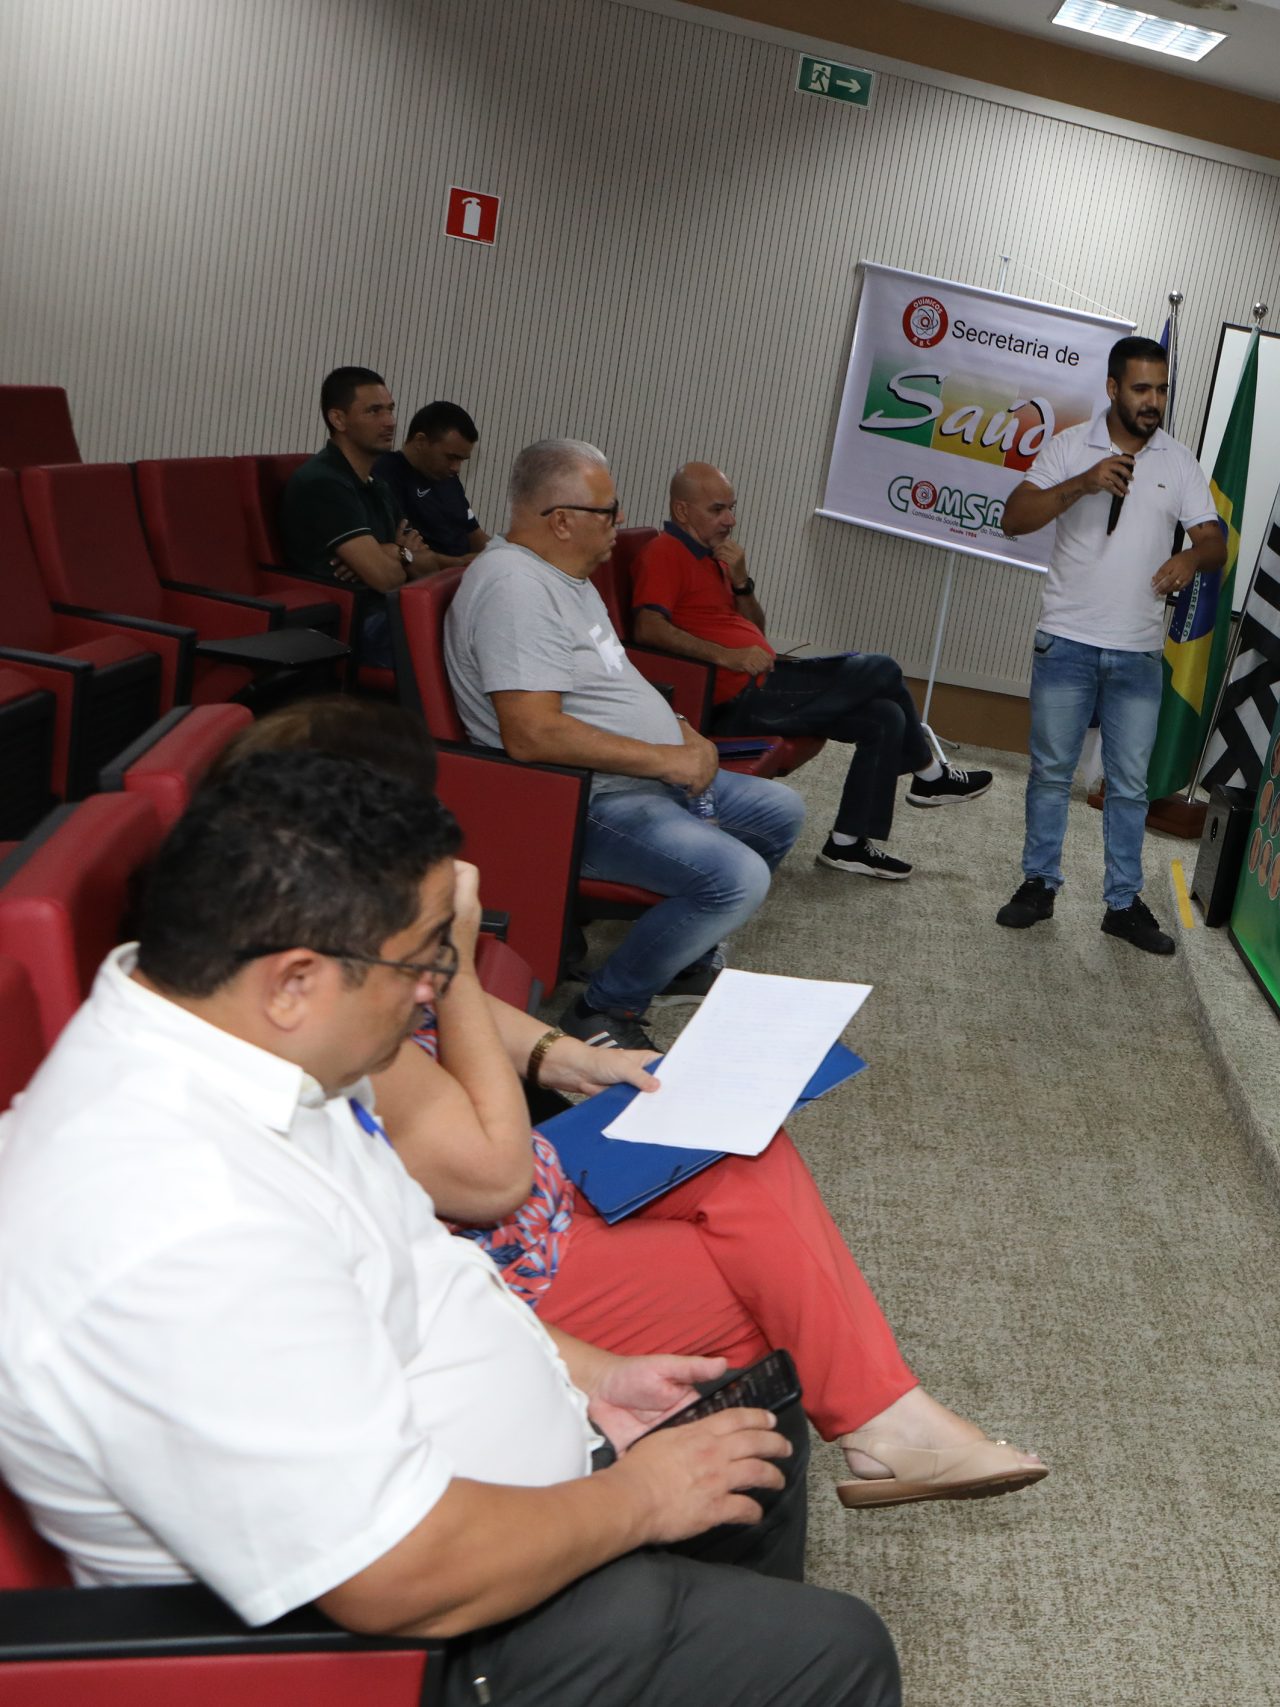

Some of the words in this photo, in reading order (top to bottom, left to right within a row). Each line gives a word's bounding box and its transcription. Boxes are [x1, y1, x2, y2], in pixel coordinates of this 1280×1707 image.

[913, 298, 943, 315] QUÍMICOS
[952, 320, 1048, 359] Secretaria
[1055, 346, 1080, 366] de
[859, 366, 1056, 457] Saúd
[888, 475, 1007, 531] COMSA
[943, 517, 959, 527] Saúde
